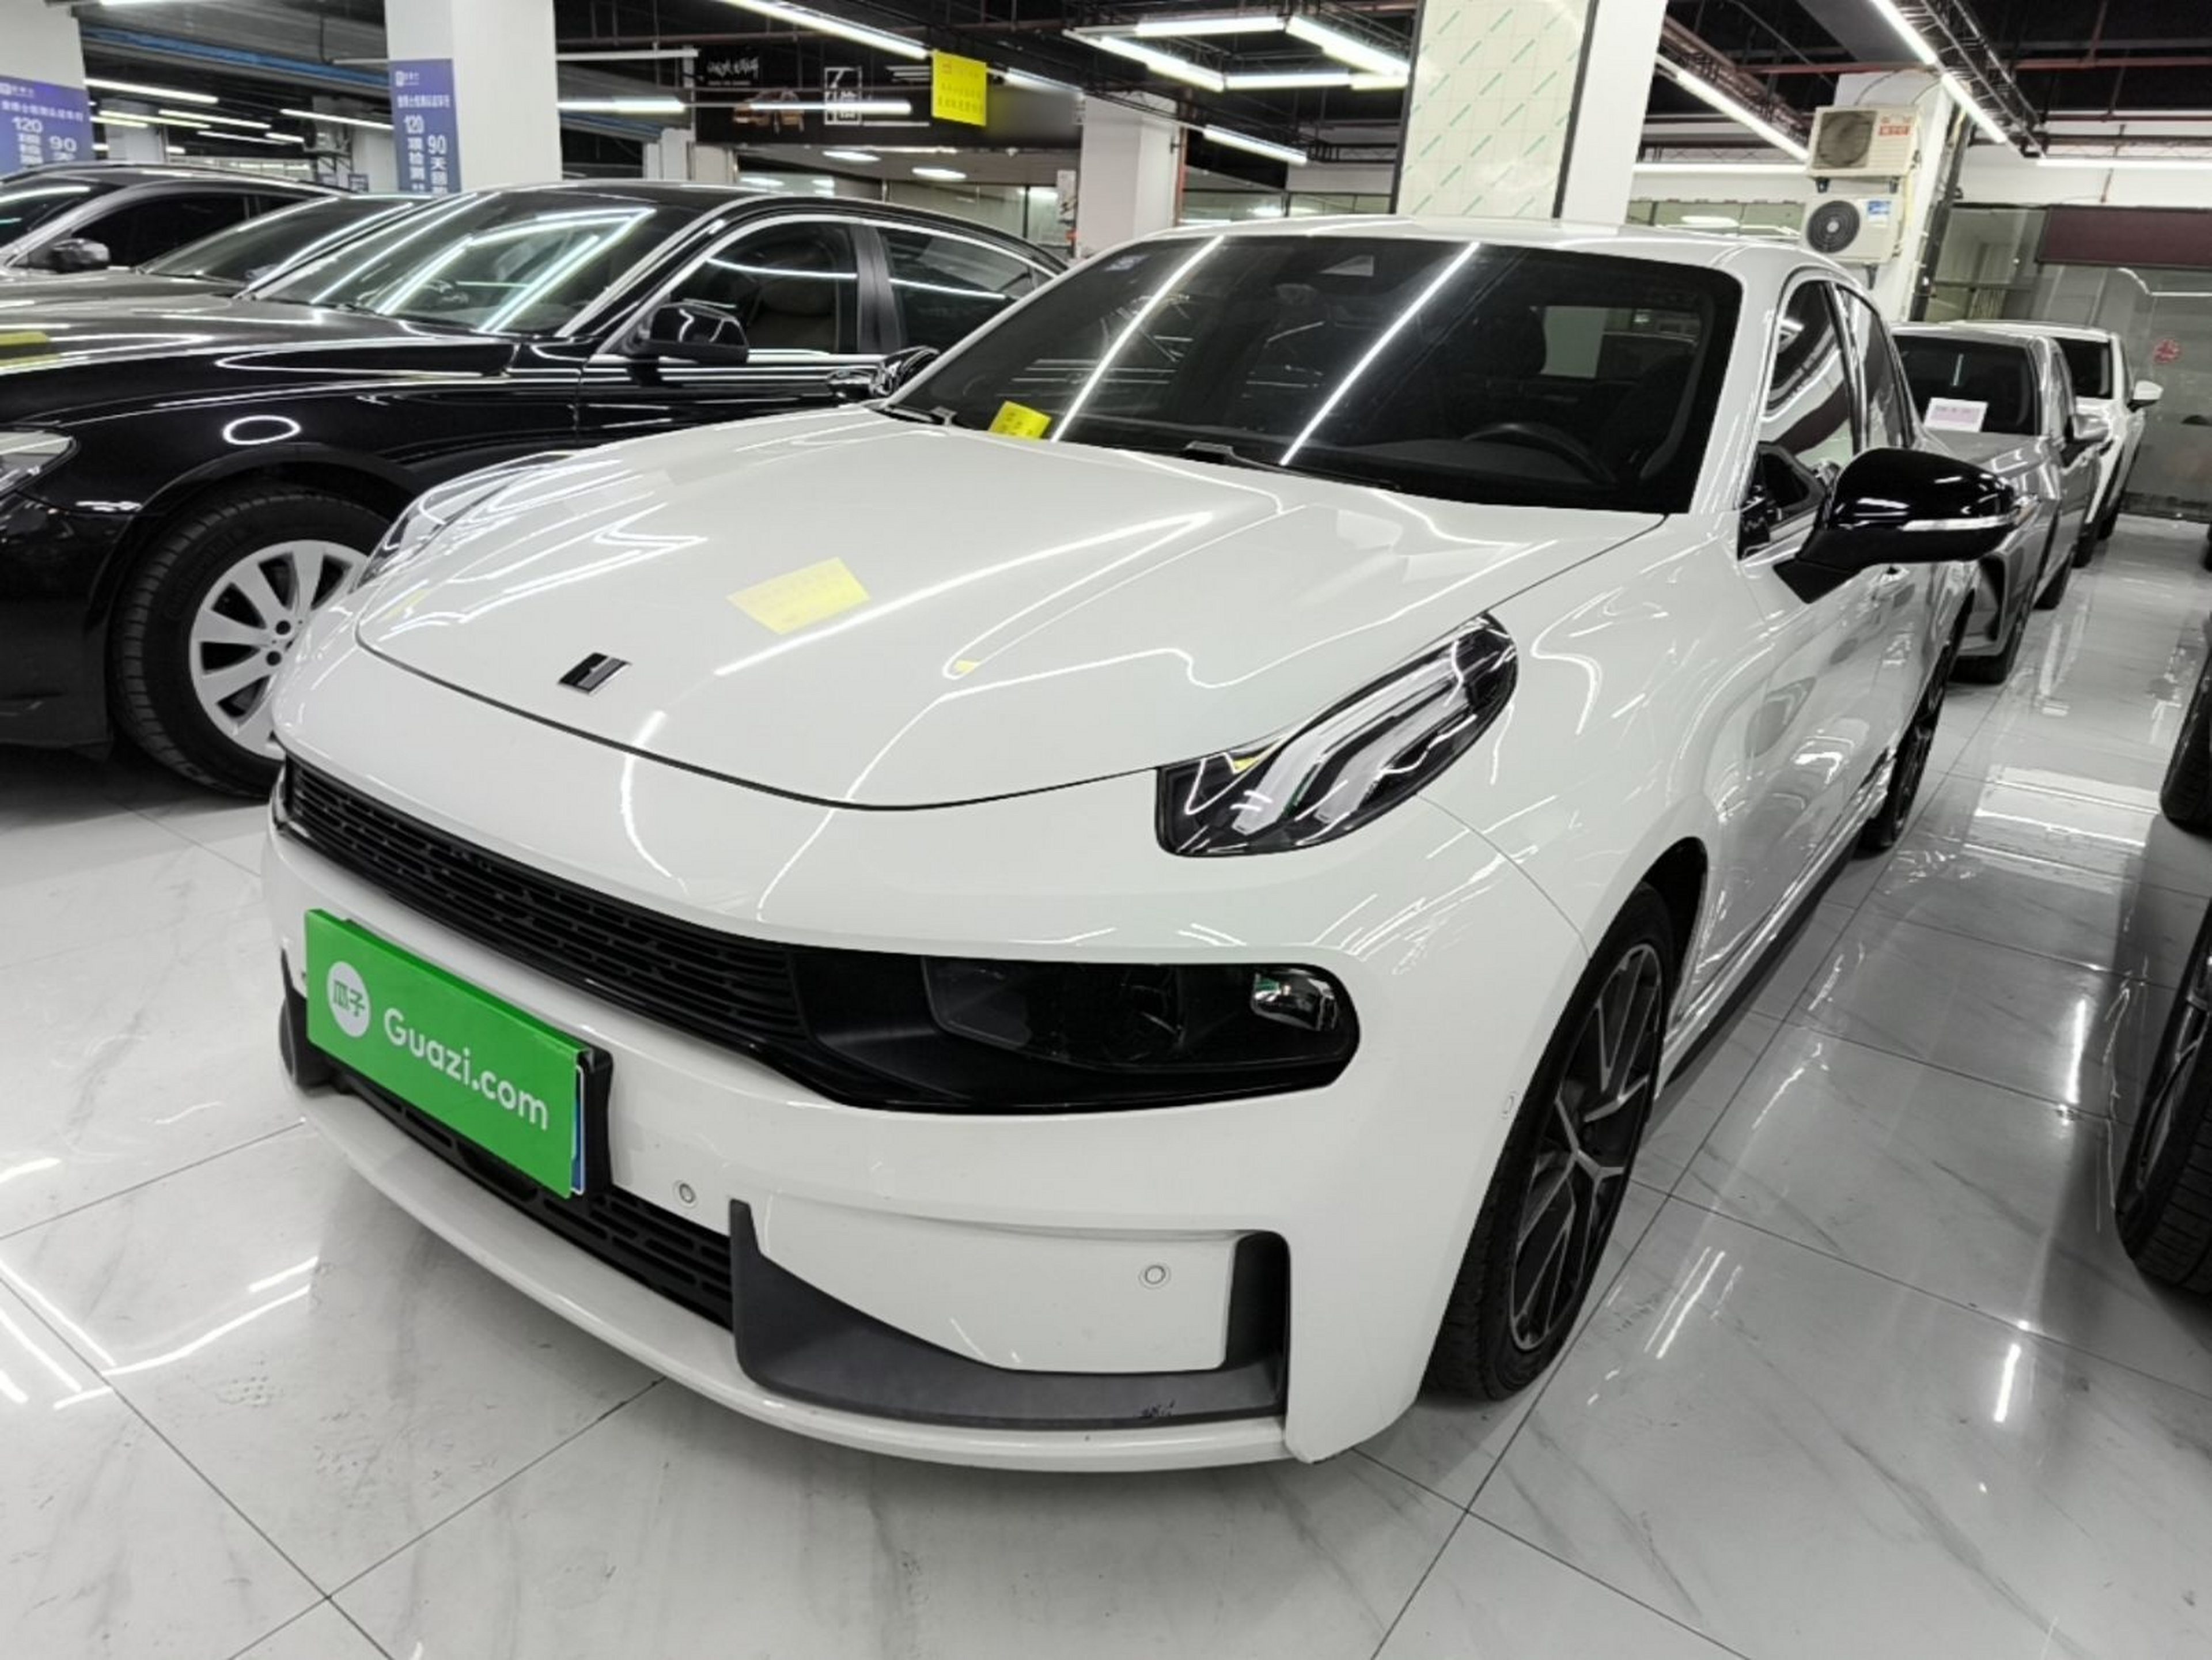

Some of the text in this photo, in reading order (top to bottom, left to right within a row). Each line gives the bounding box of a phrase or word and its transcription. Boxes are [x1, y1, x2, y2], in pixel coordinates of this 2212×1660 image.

[12, 116, 43, 133] 120
[404, 115, 424, 134] 120
[50, 135, 77, 152] 90
[428, 134, 448, 154] 90
[333, 981, 366, 1018] 瓜子
[384, 1007, 548, 1130] Guazi.com
